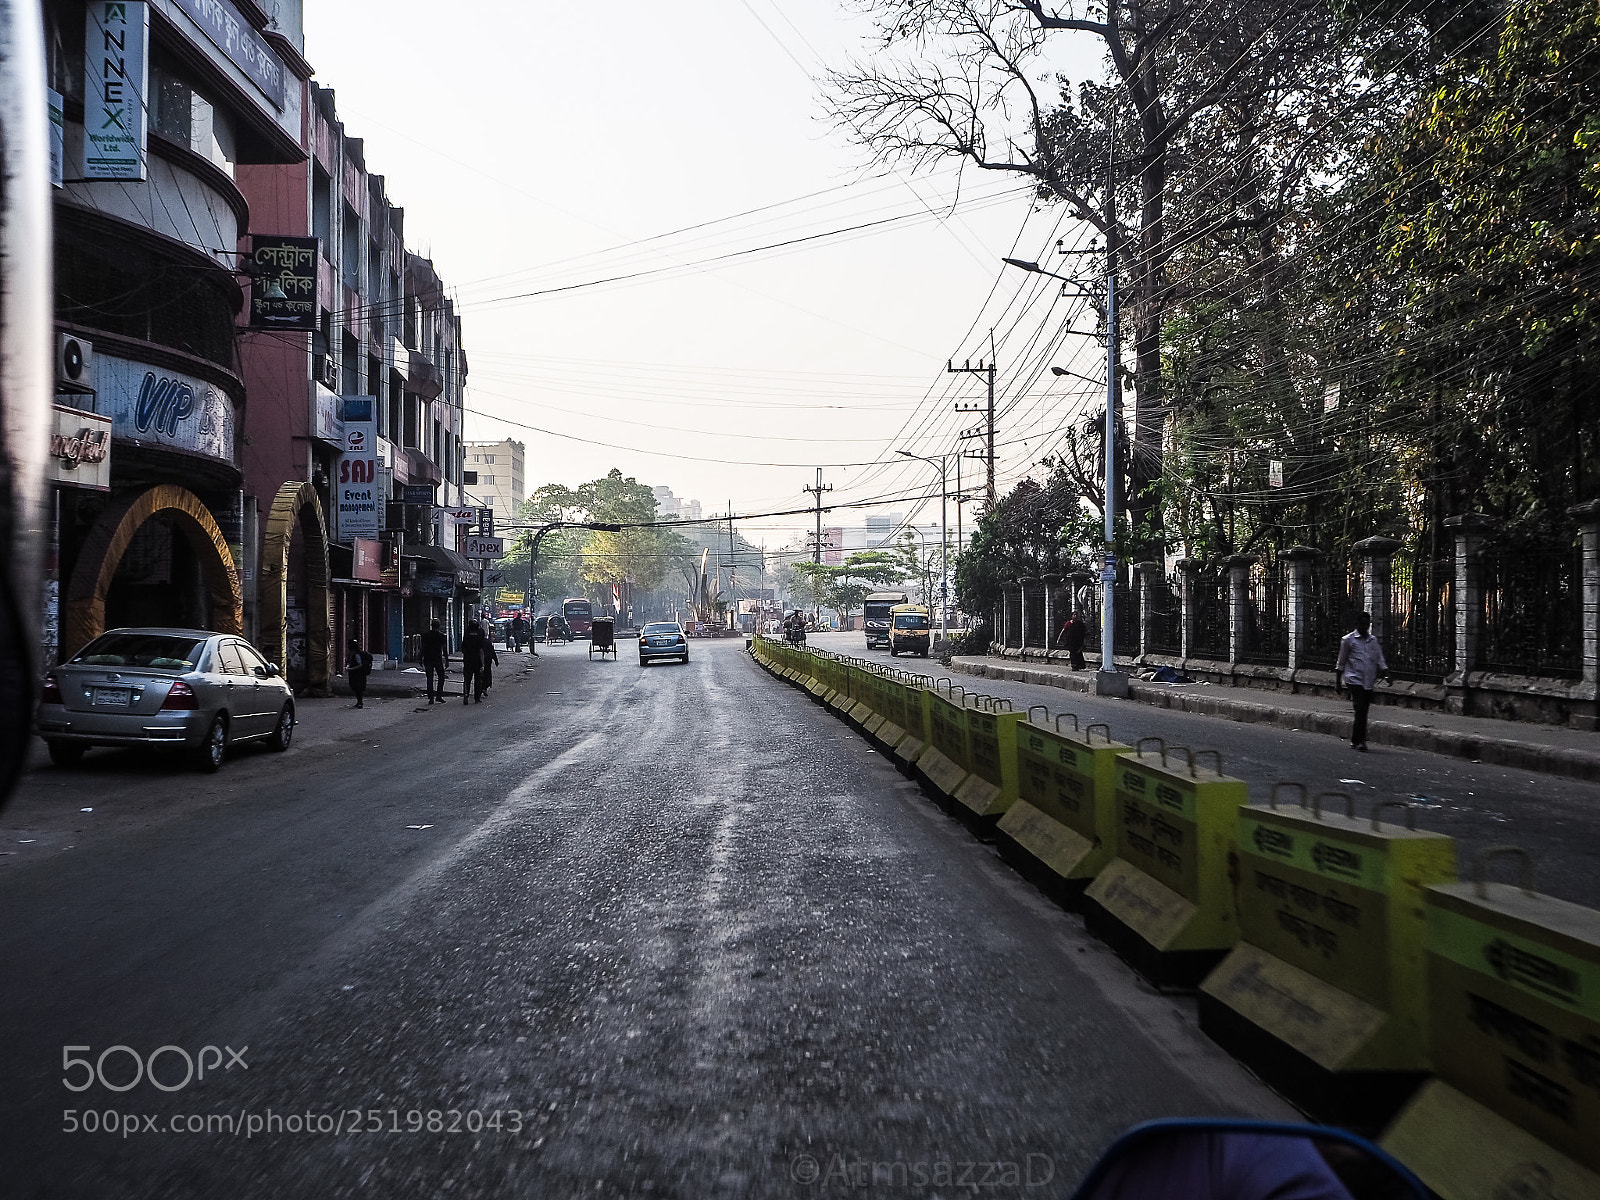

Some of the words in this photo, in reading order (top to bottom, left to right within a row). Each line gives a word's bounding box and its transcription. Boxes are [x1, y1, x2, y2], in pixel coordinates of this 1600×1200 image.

[101, 3, 126, 129] ANNEX
[90, 133, 135, 143] Worldwide
[103, 143, 121, 152] Ltd.
[255, 242, 314, 270] সেন্ট্রাল
[135, 371, 195, 438] VIP
[340, 459, 375, 484] SAJ
[344, 489, 372, 501] Event
[339, 501, 376, 515] management
[469, 539, 500, 555] Apex
